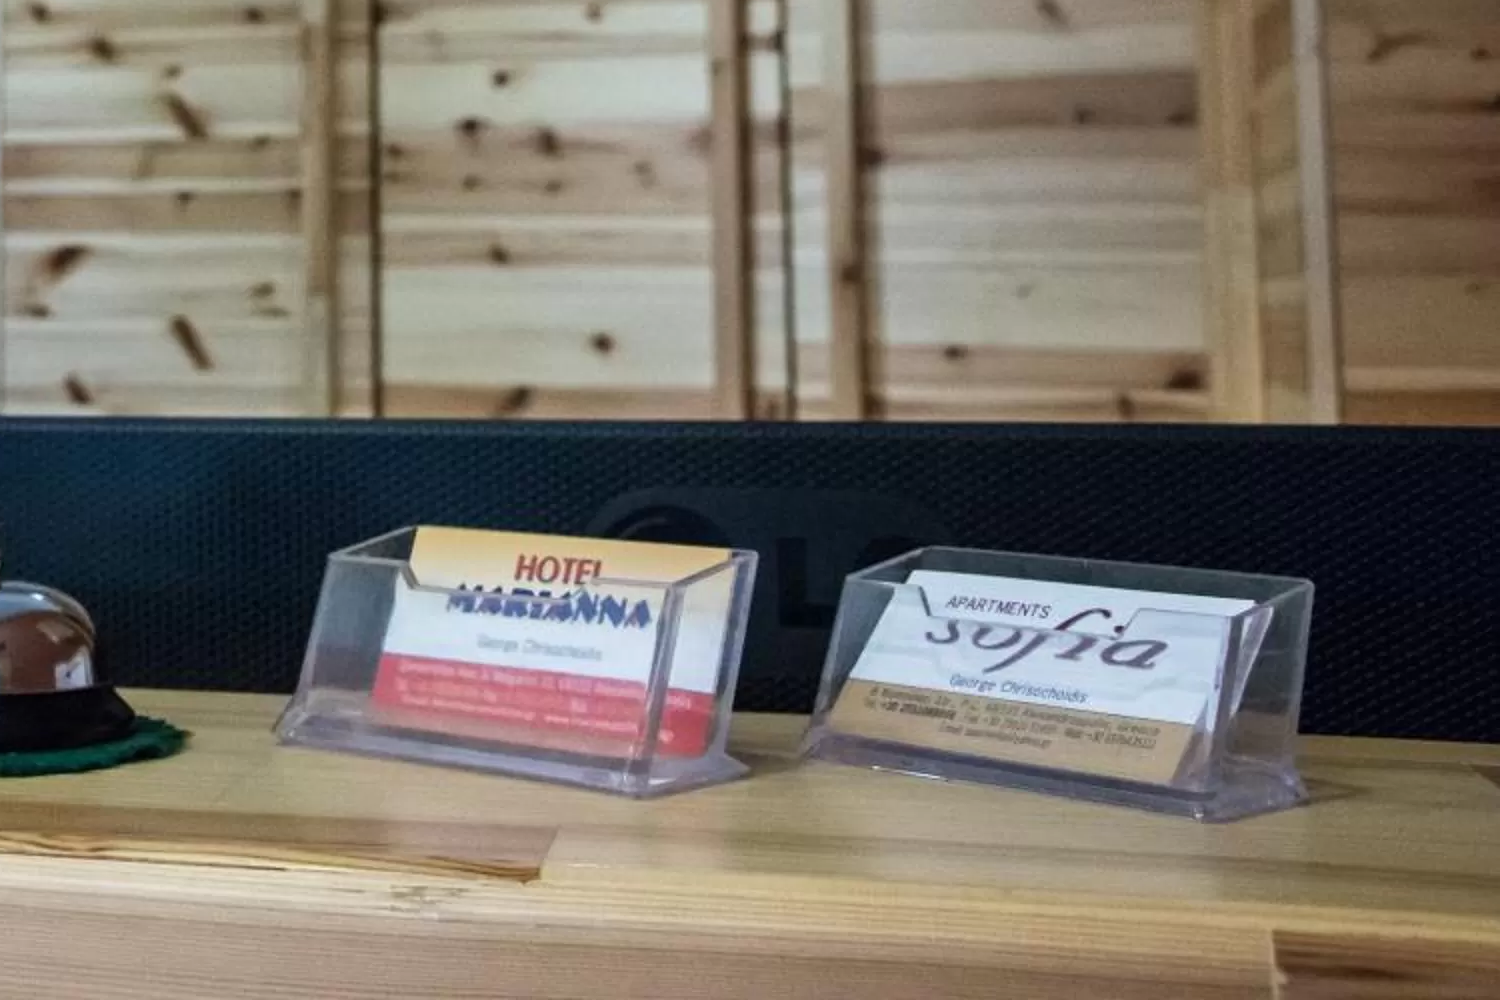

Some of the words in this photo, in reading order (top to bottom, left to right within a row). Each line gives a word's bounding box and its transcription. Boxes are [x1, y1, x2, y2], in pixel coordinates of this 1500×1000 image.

[446, 584, 651, 628] MARIANNA
[945, 595, 1053, 620] APARTMENTS
[949, 673, 997, 693] George
